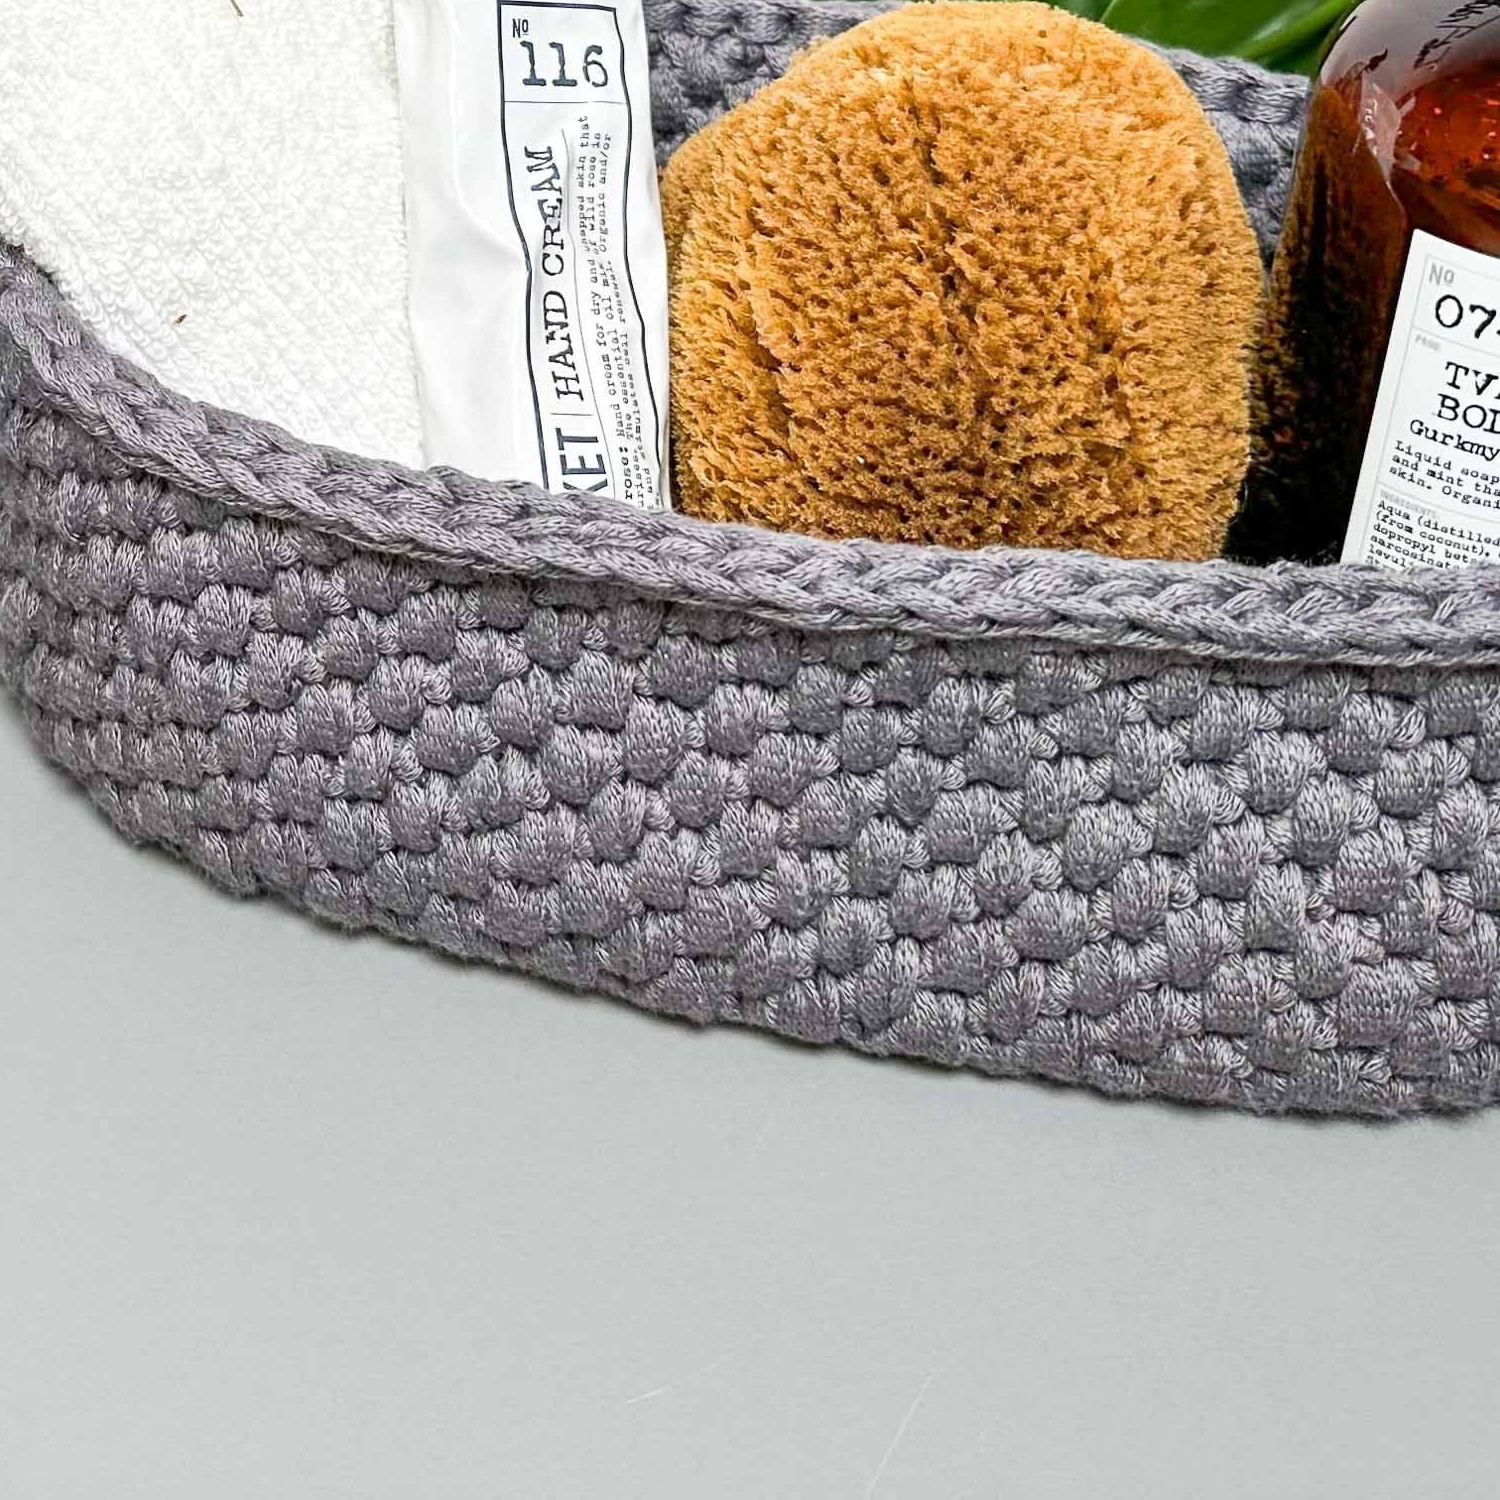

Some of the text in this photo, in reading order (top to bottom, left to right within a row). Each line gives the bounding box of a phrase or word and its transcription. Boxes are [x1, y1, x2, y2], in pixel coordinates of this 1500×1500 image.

[520, 40, 608, 87] 116
[576, 114, 589, 148] that
[591, 132, 600, 149] is
[575, 155, 586, 188] skin
[587, 155, 596, 188] rose
[599, 132, 611, 184] and/or
[523, 146, 565, 277] CREAM
[587, 259, 598, 284] and
[589, 290, 601, 315] dry
[601, 295, 614, 320] oil
[1435, 294, 1500, 338] 07
[543, 290, 584, 401] HAND
[594, 323, 606, 347] for
[601, 353, 617, 396] cream
[1445, 361, 1500, 399] TV
[610, 402, 625, 438] Hand
[1392, 454, 1419, 472] and
[1426, 468, 1464, 487] mint
[1395, 440, 1453, 470] Liquid
[1389, 466, 1432, 490] skin.
[1376, 510, 1414, 534] (from
[1378, 500, 1411, 521] Aqua
[1369, 545, 1413, 568] levul
